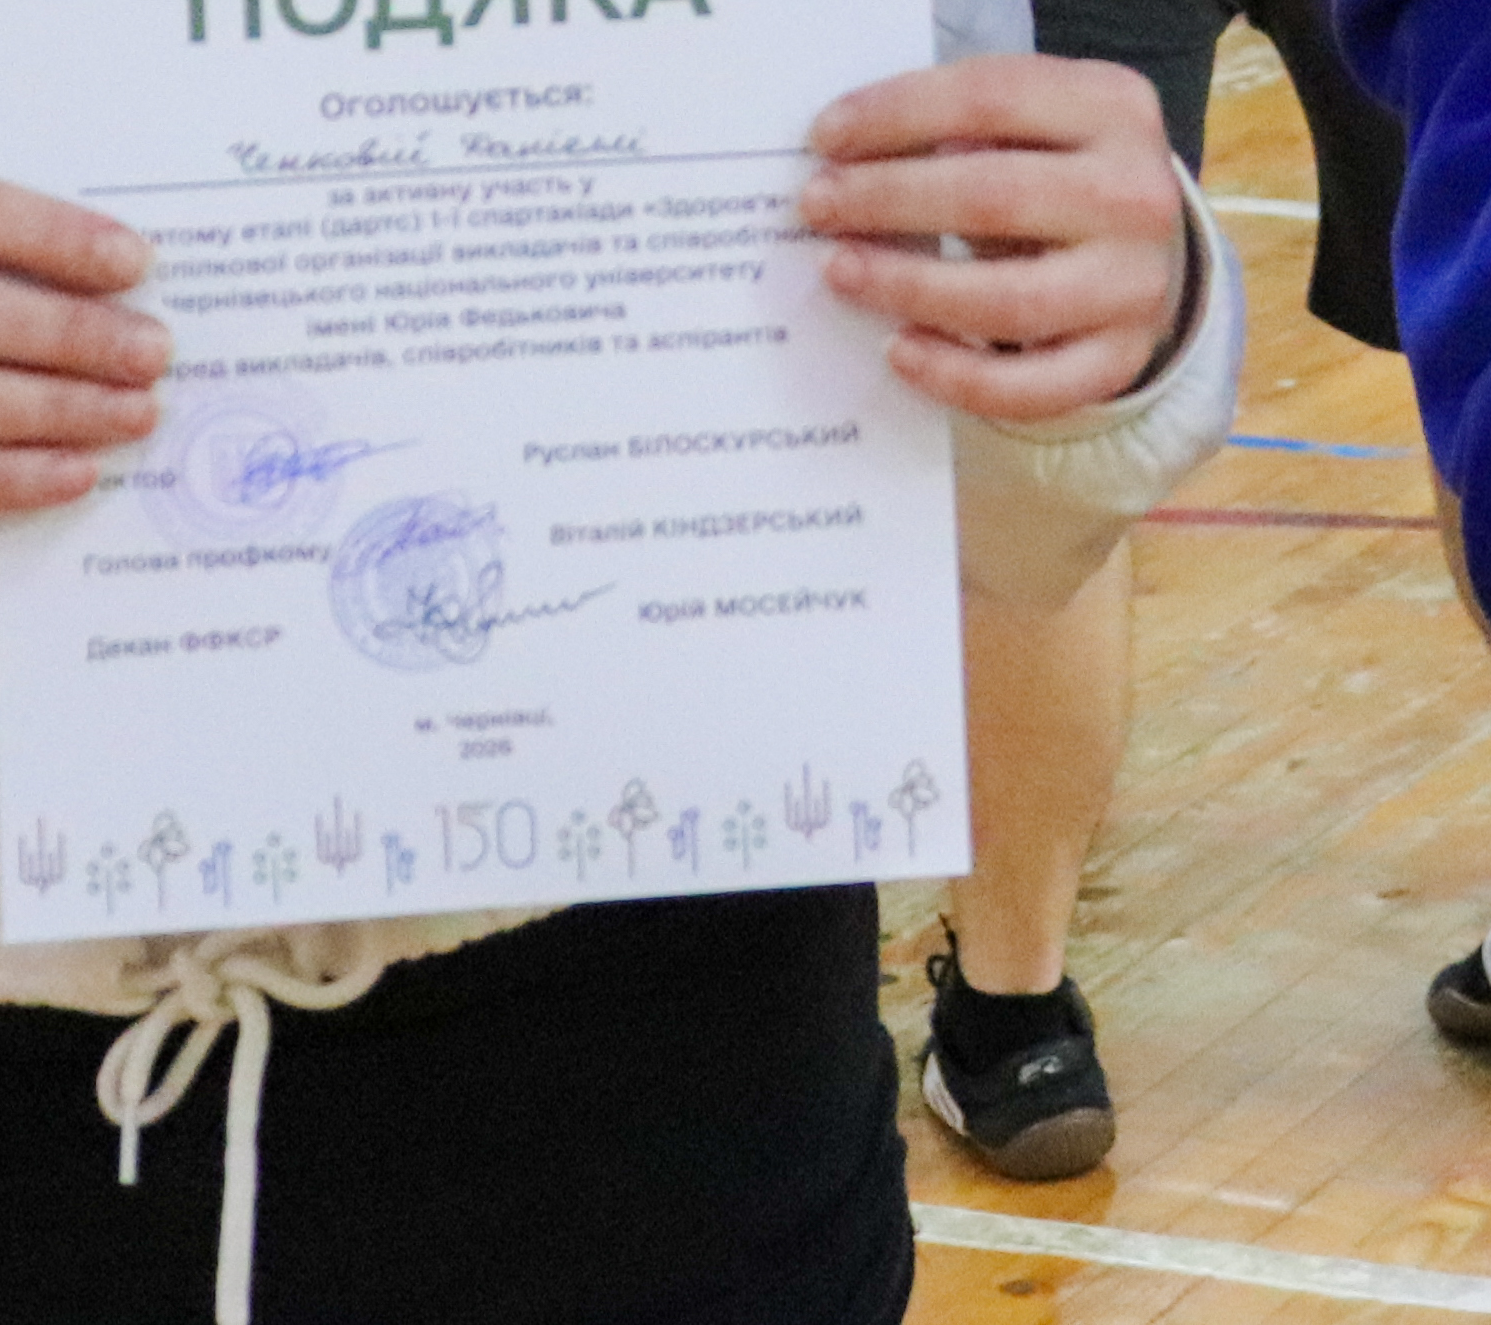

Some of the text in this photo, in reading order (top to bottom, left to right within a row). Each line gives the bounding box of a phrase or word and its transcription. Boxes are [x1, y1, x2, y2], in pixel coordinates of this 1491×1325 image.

[318, 82, 593, 121] Оголошується:
[328, 175, 594, 207] за активну участь у
[240, 220, 311, 242] етапі
[320, 212, 422, 239] (дартс)
[466, 202, 633, 227] спартакіади
[293, 241, 443, 275] організації
[451, 237, 602, 262] викладачів
[613, 236, 638, 251] та
[160, 258, 765, 320] Чернівецького національного університету
[306, 301, 626, 337] імені Юрія Федьковича
[401, 335, 601, 365] співробітників
[612, 335, 638, 351] та
[647, 323, 788, 350] аспірантів
[522, 441, 619, 466] Руслан
[627, 417, 861, 457] БІЛОСКУРСЬКИЙ
[82, 500, 864, 575] Голова профкому Віталій КІНДЗЕРСЬКИЙ
[85, 586, 866, 662] Декан ФФКСР Юрій МОСЕЙЧУК
[432, 794, 542, 877] 150
